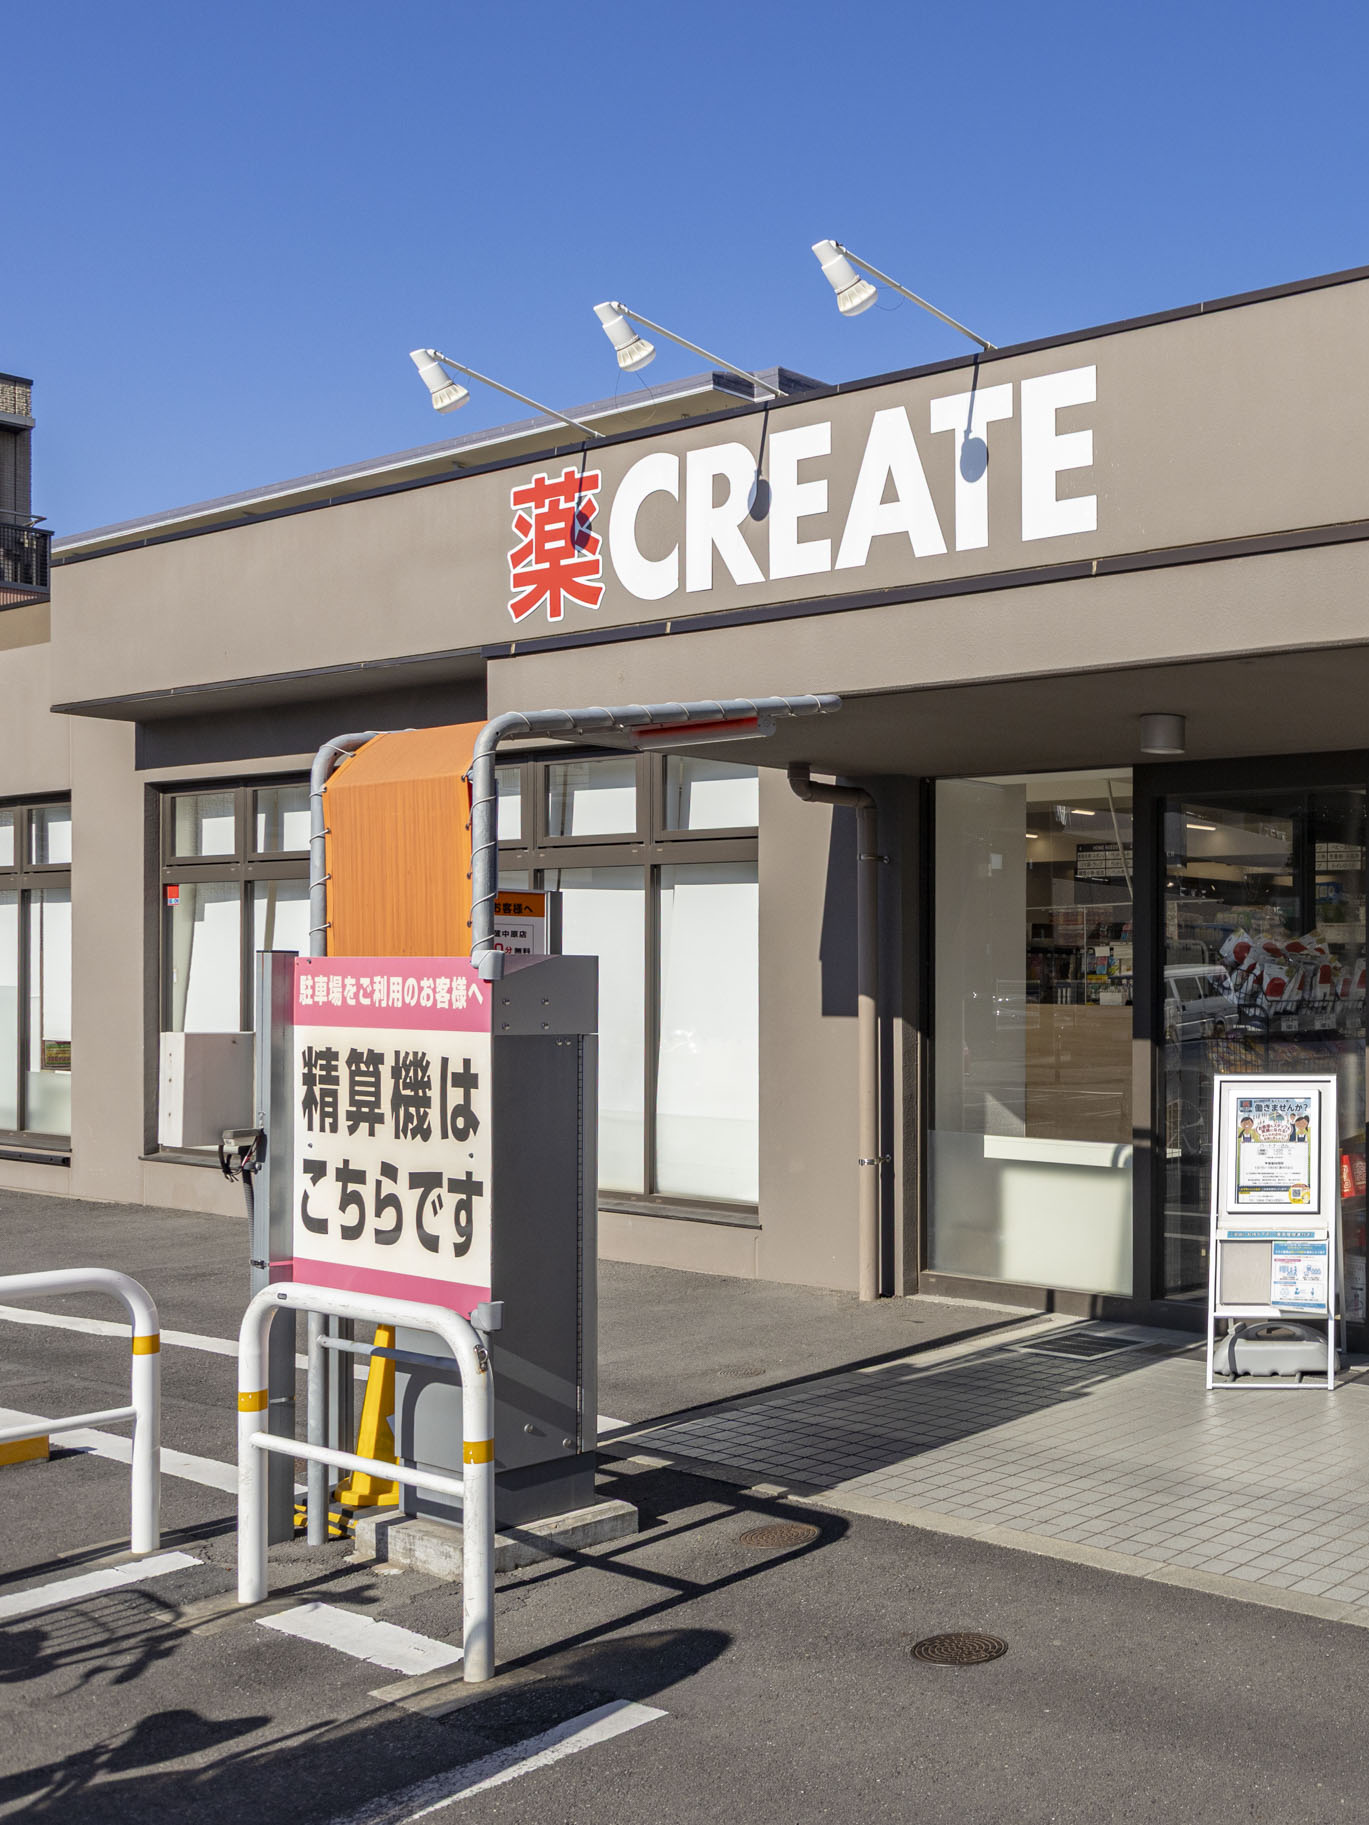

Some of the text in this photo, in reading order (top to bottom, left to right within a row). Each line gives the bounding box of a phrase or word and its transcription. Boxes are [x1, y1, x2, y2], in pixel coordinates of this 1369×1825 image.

[608, 365, 1098, 600] CREATE
[507, 465, 607, 623] 薬
[298, 975, 484, 1009] 駐車場をご利用のお客様へ
[302, 1046, 480, 1142] 精算機は
[300, 1158, 484, 1258] こちらです
